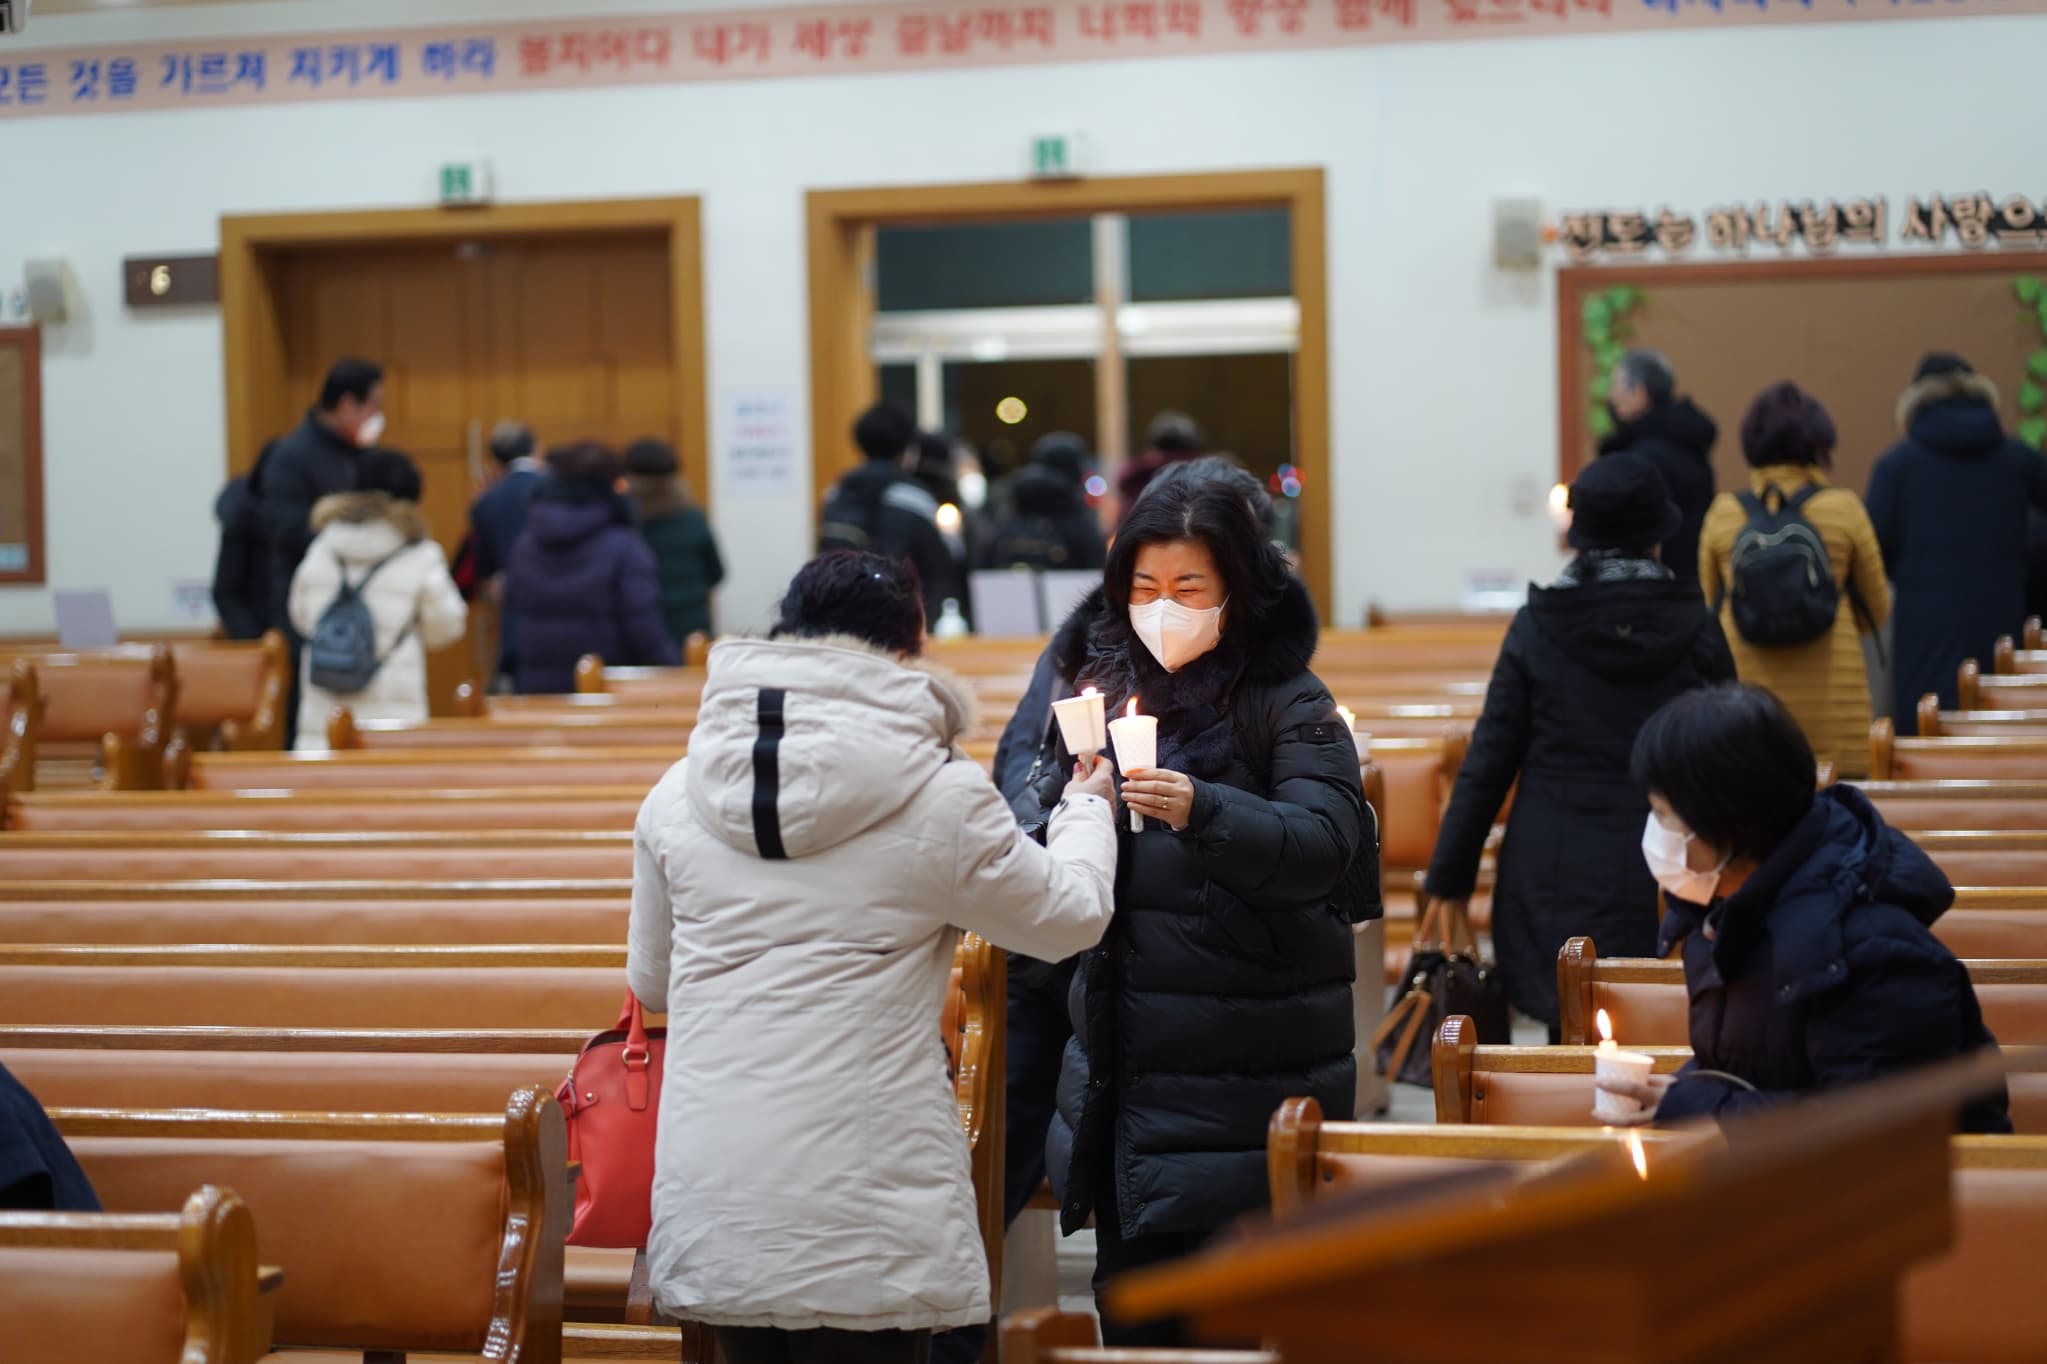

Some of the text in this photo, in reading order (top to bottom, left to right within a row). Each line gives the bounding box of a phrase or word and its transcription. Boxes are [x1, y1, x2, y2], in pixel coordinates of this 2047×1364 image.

[69, 57, 137, 101] 것을
[161, 51, 266, 93] 가르쳐
[289, 42, 401, 90] 지키게
[421, 37, 495, 84] 하라
[692, 22, 771, 65] 내가
[1706, 194, 1888, 254] 하나님의
[1898, 189, 2047, 250] 사랑으
[150, 264, 171, 296] 6
